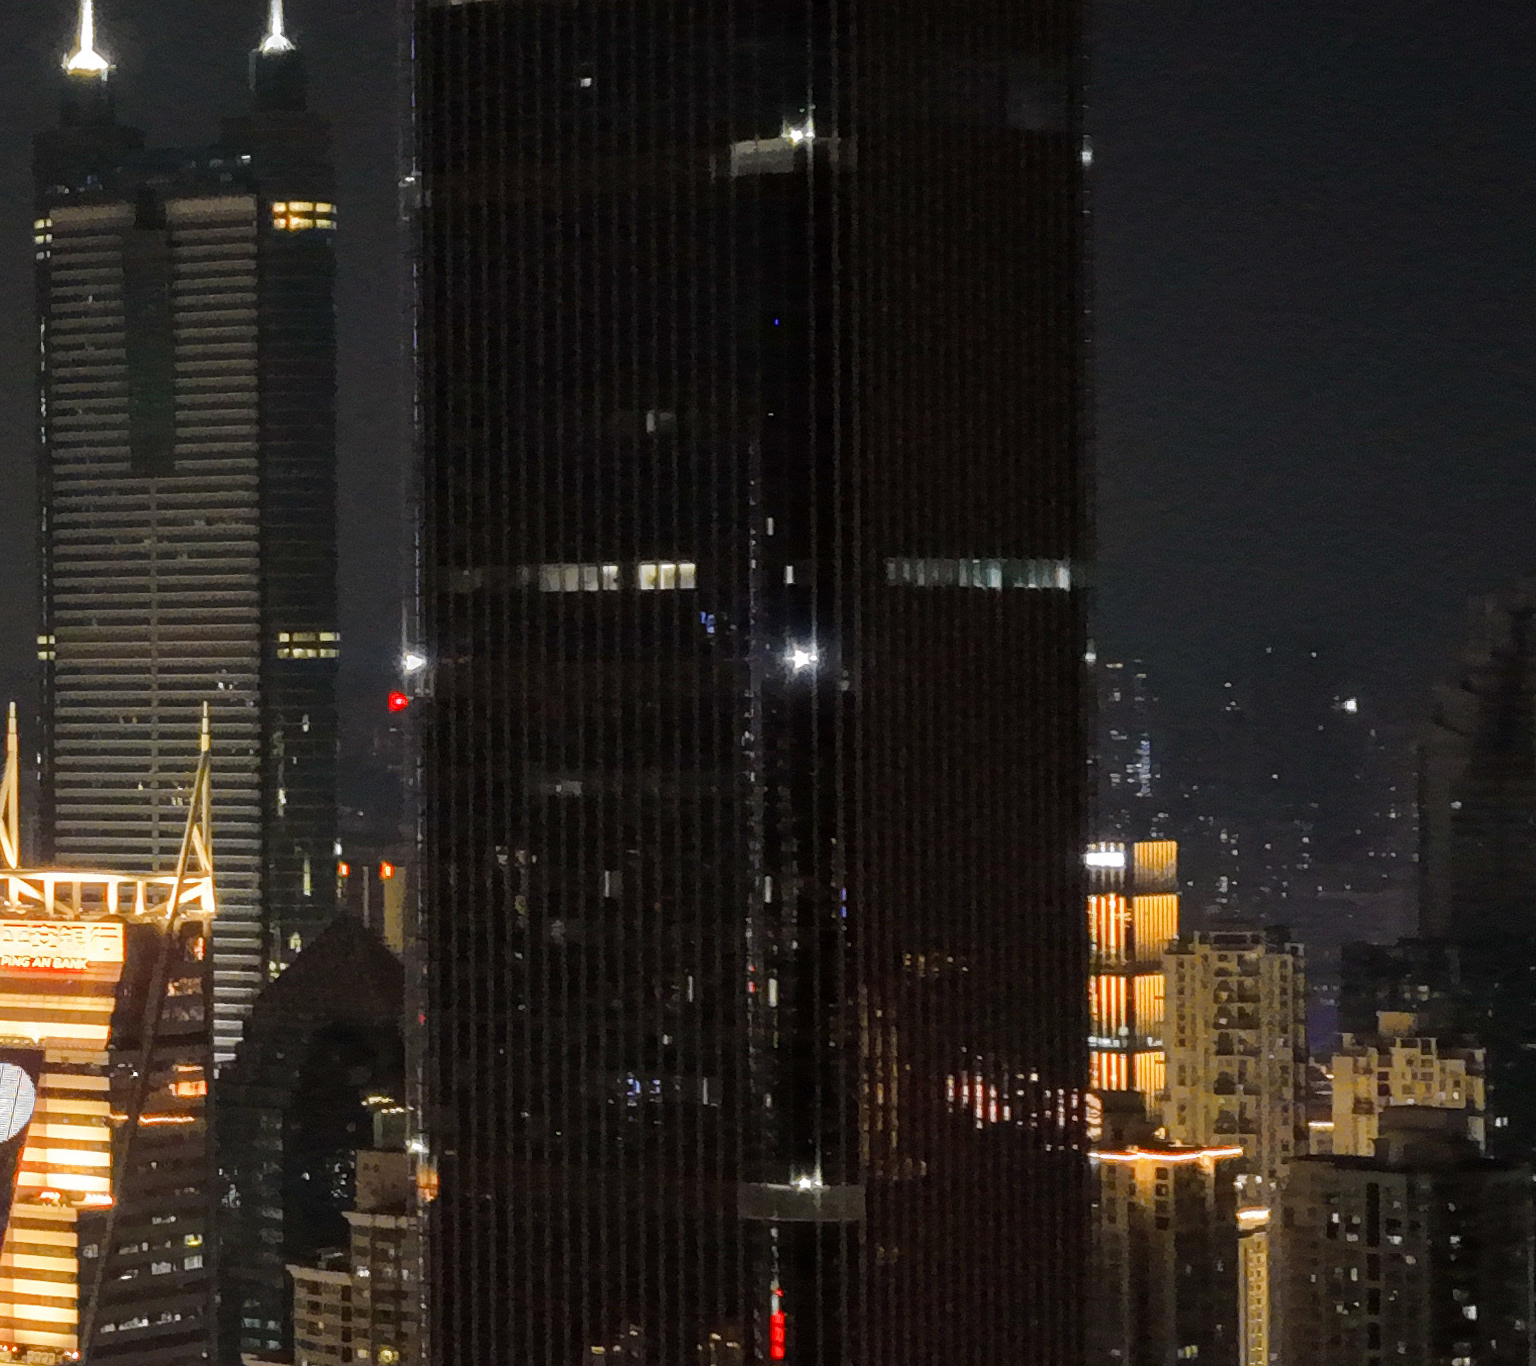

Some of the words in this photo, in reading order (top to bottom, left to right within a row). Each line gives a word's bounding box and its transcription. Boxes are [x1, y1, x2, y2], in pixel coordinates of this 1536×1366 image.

[0, 956, 30, 968] PING
[32, 957, 51, 968] AN
[52, 957, 89, 970] BANK
